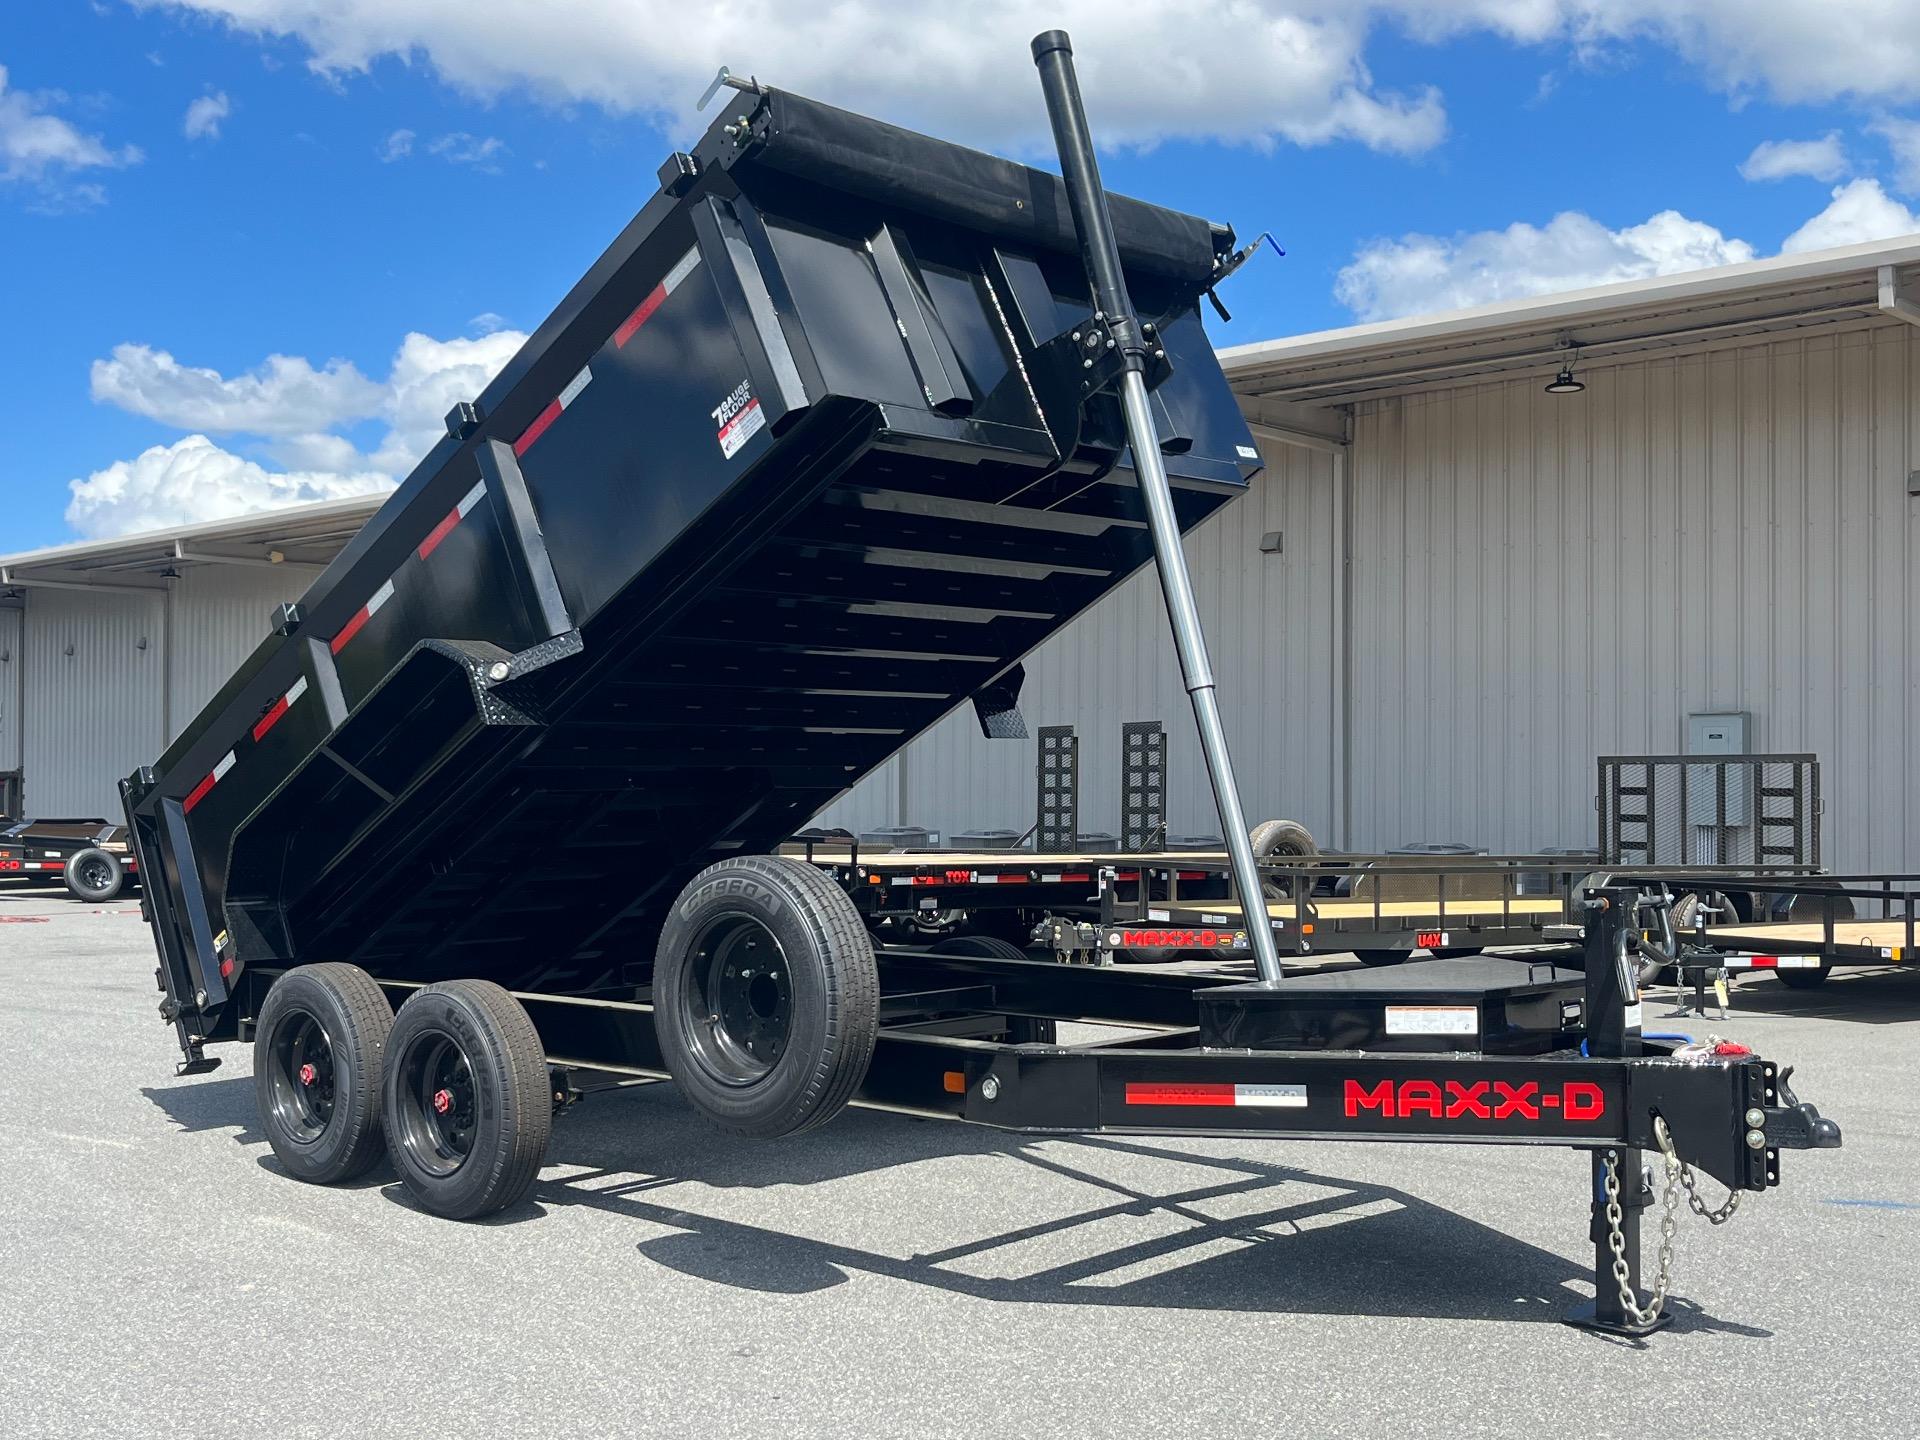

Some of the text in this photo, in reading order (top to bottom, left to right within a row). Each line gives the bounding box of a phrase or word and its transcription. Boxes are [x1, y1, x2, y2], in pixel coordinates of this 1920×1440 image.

[711, 406, 724, 428] 7
[721, 379, 751, 412] GAUGE
[723, 391, 751, 422] FLOOR
[1123, 930, 1217, 947] MAXX-D
[1418, 933, 1441, 947] U4X
[1343, 1079, 1604, 1120] MAXX-D
